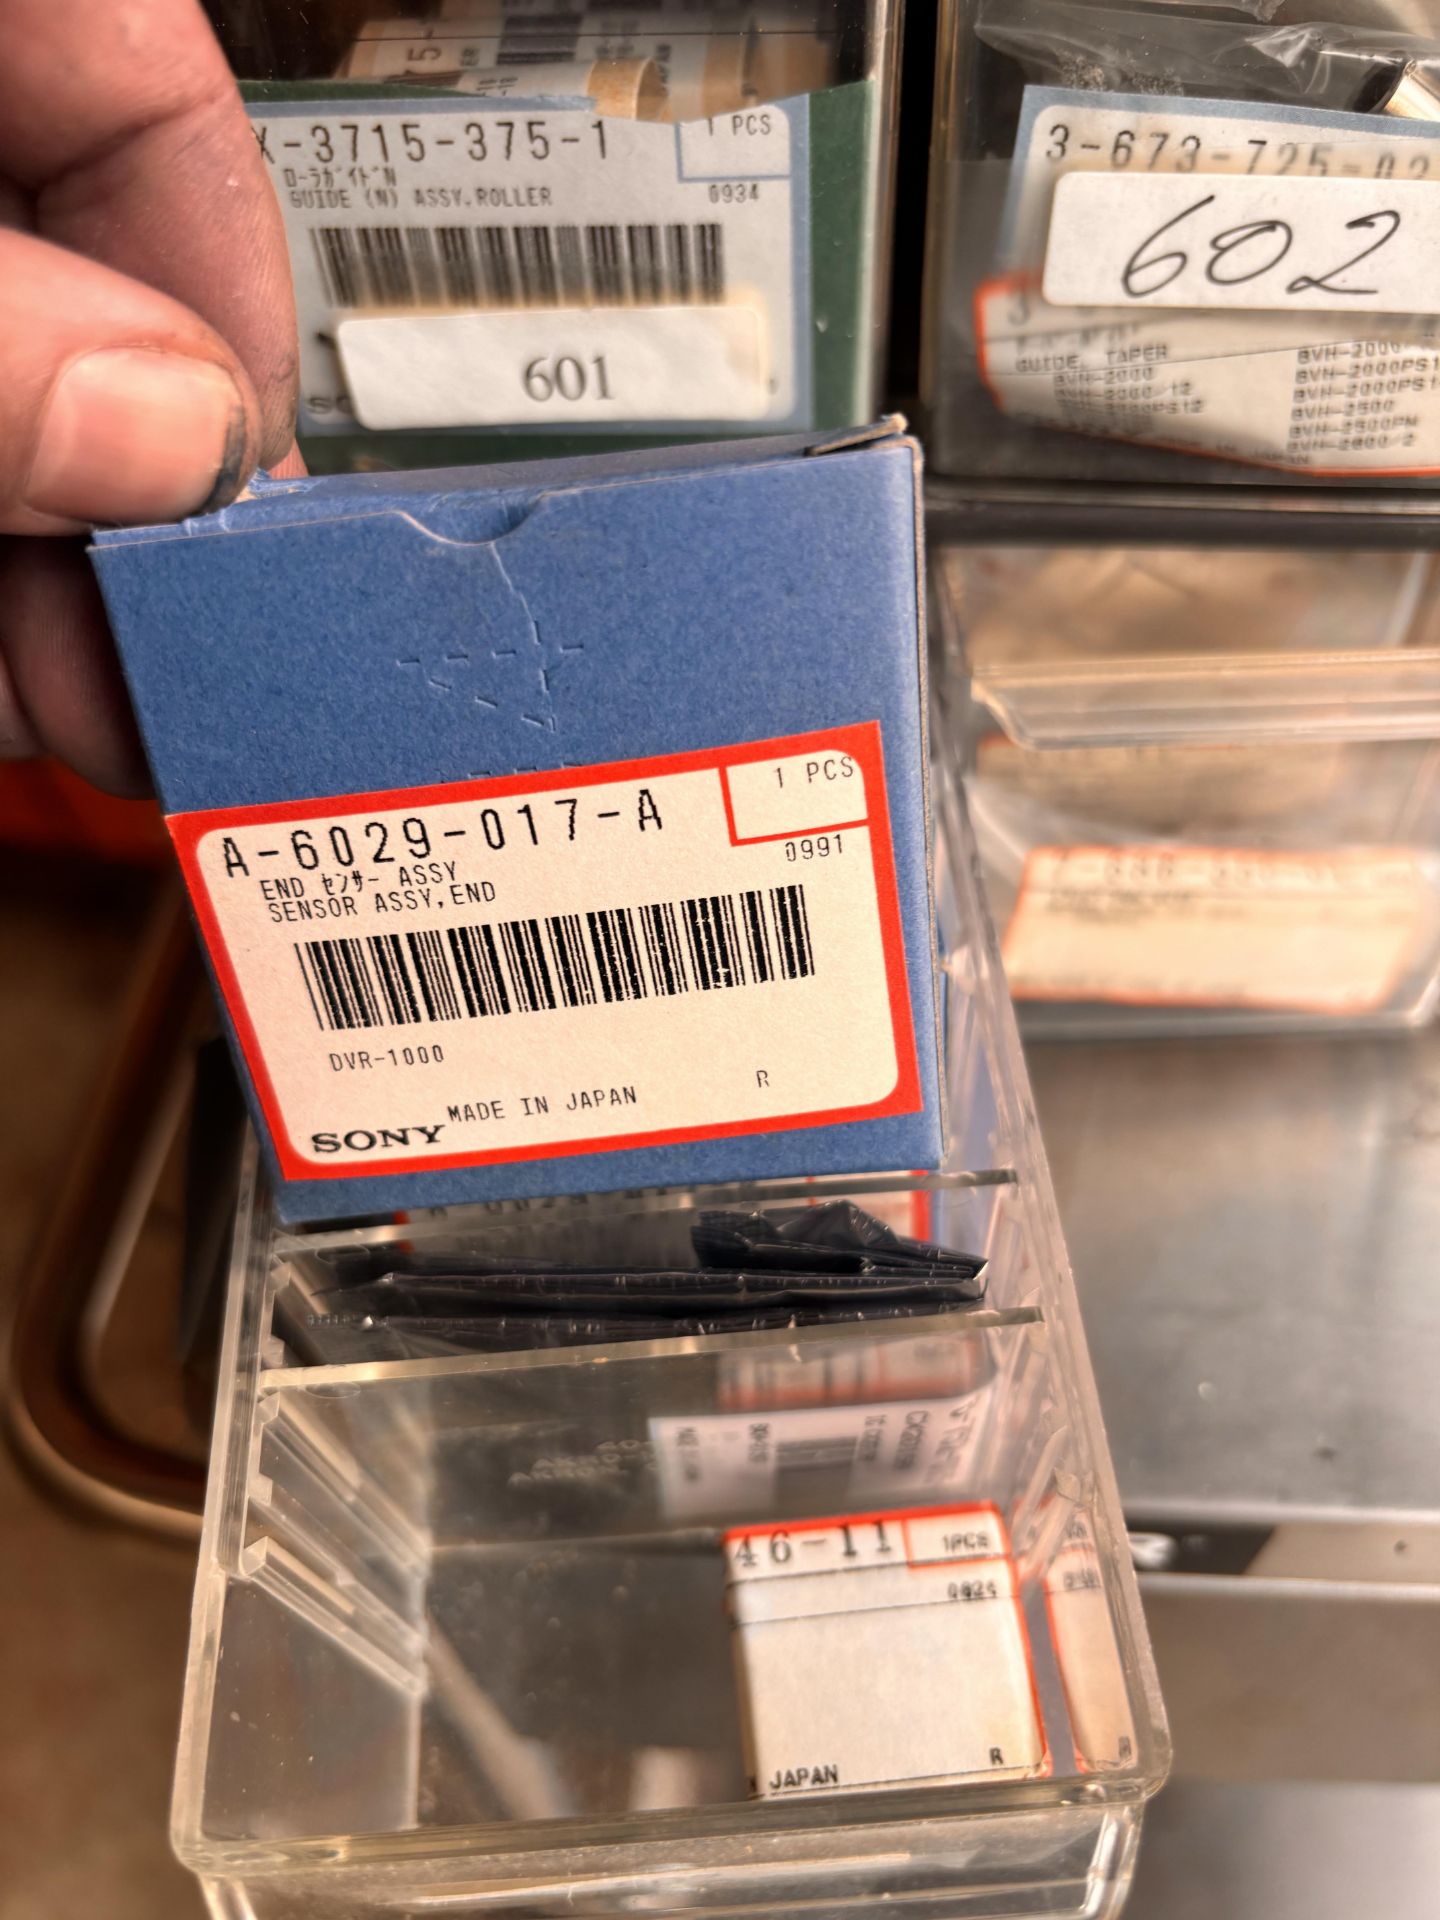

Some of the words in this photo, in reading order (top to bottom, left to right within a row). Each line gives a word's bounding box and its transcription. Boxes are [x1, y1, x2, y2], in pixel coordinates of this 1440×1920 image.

[732, 113, 772, 136] PCS
[252, 119, 607, 164] X-3715-375-1
[289, 188, 350, 209] GUIDE
[708, 183, 760, 204] 0934
[1122, 194, 1401, 299] 602
[522, 355, 616, 402] 601
[776, 767, 784, 788] 1
[806, 756, 854, 783] PCS
[222, 789, 662, 878] A-6029-017-A
[785, 834, 844, 862] 0991
[260, 877, 305, 900] END
[399, 861, 457, 887] ASSY
[269, 896, 358, 923] SENSOR
[375, 882, 496, 914] ASSY,END
[329, 1045, 445, 1072] DVR-1000
[756, 1069, 770, 1088] R
[447, 1100, 506, 1123] MADE
[521, 1096, 549, 1116] IN
[566, 1086, 638, 1112] JAPAN
[311, 1124, 446, 1153] SONY
[988, 1747, 1005, 1766] R
[769, 1764, 839, 1790] JAPAN
